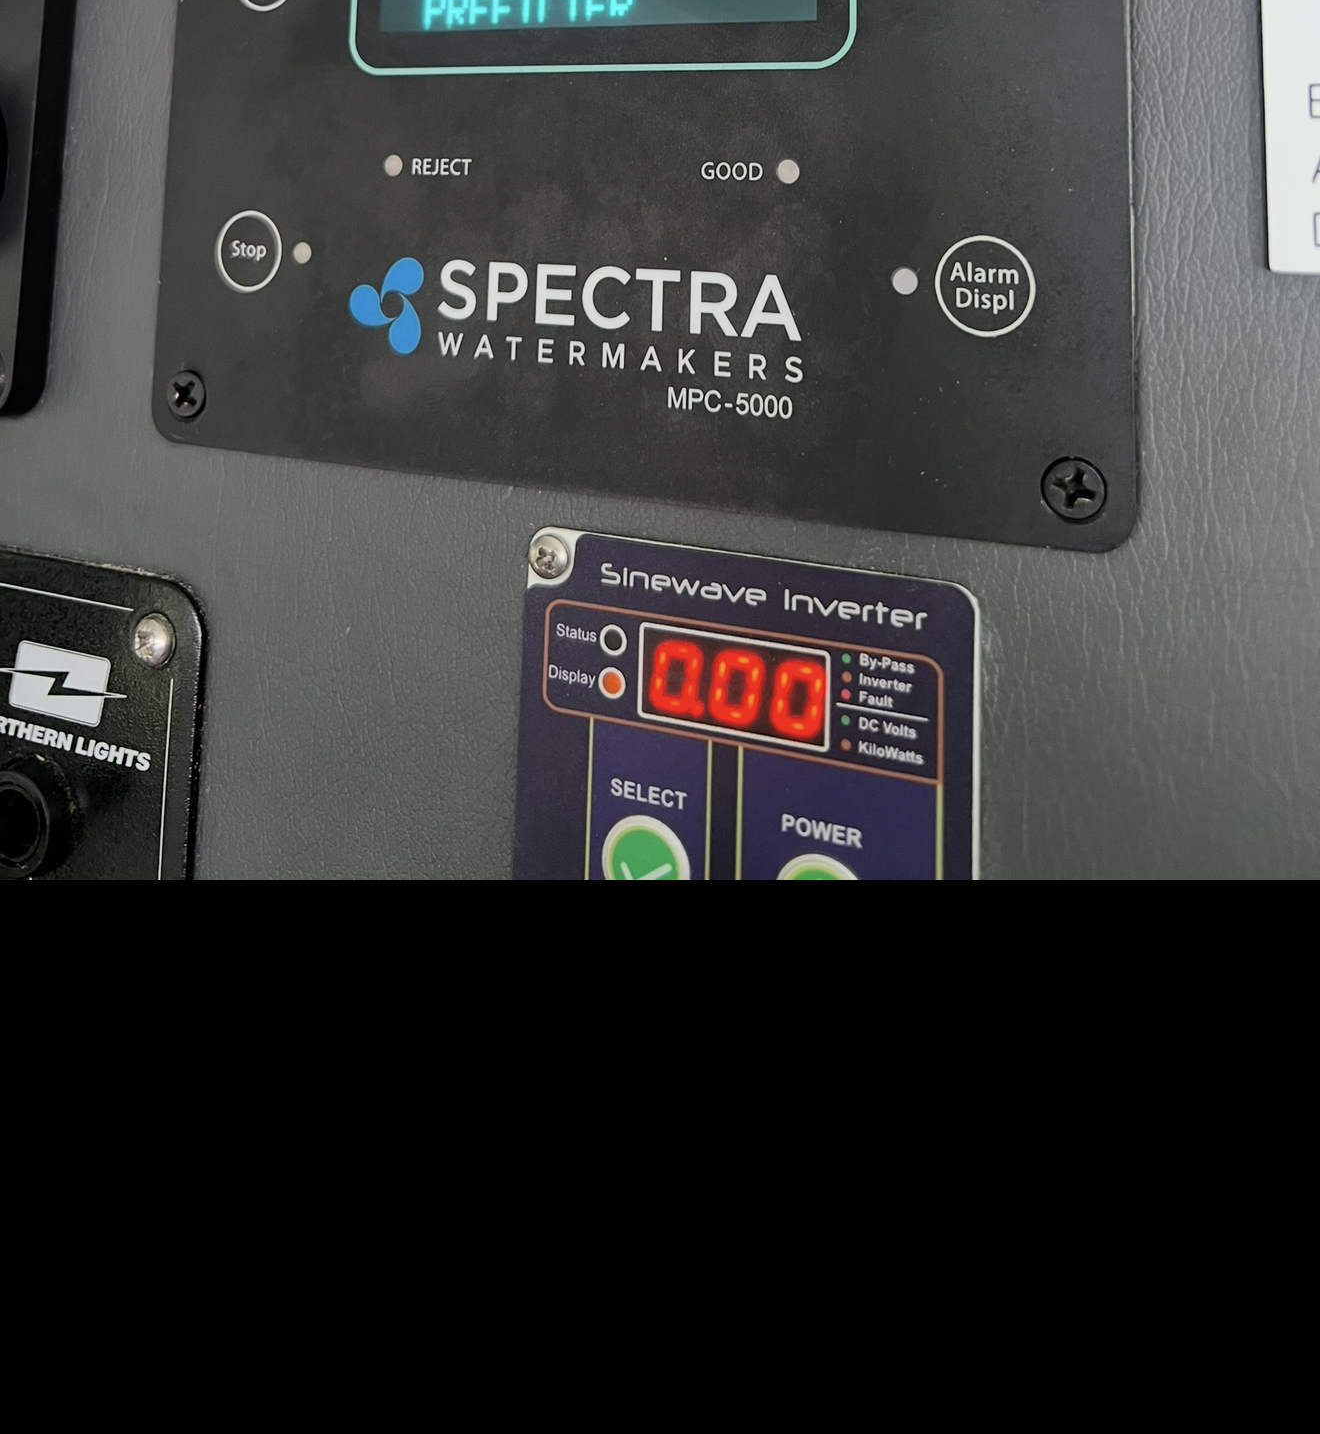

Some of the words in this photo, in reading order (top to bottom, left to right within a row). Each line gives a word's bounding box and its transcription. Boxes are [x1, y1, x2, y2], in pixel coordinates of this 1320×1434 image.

[411, 158, 473, 177] REJECT
[700, 161, 764, 181] GOOD
[231, 240, 267, 261] Stop
[950, 261, 1019, 285] Alarm
[437, 258, 802, 342] SPECTRA
[955, 287, 1014, 315] Displ
[437, 330, 804, 384] WATERMAKERS
[666, 385, 794, 420] MPC-5000
[599, 561, 768, 606] Sinewave
[783, 587, 928, 631] Inverter
[555, 622, 598, 644] Status
[859, 652, 916, 674] By-Pass
[547, 662, 597, 690] Display
[859, 672, 913, 693] Inverter
[859, 690, 894, 708] Fault
[858, 716, 879, 732] DC
[883, 720, 918, 739] Volts
[75, 736, 151, 772] LIGHTS
[858, 740, 925, 765] KiloWatts
[609, 777, 688, 811] SELECT
[780, 812, 864, 850] POWER
